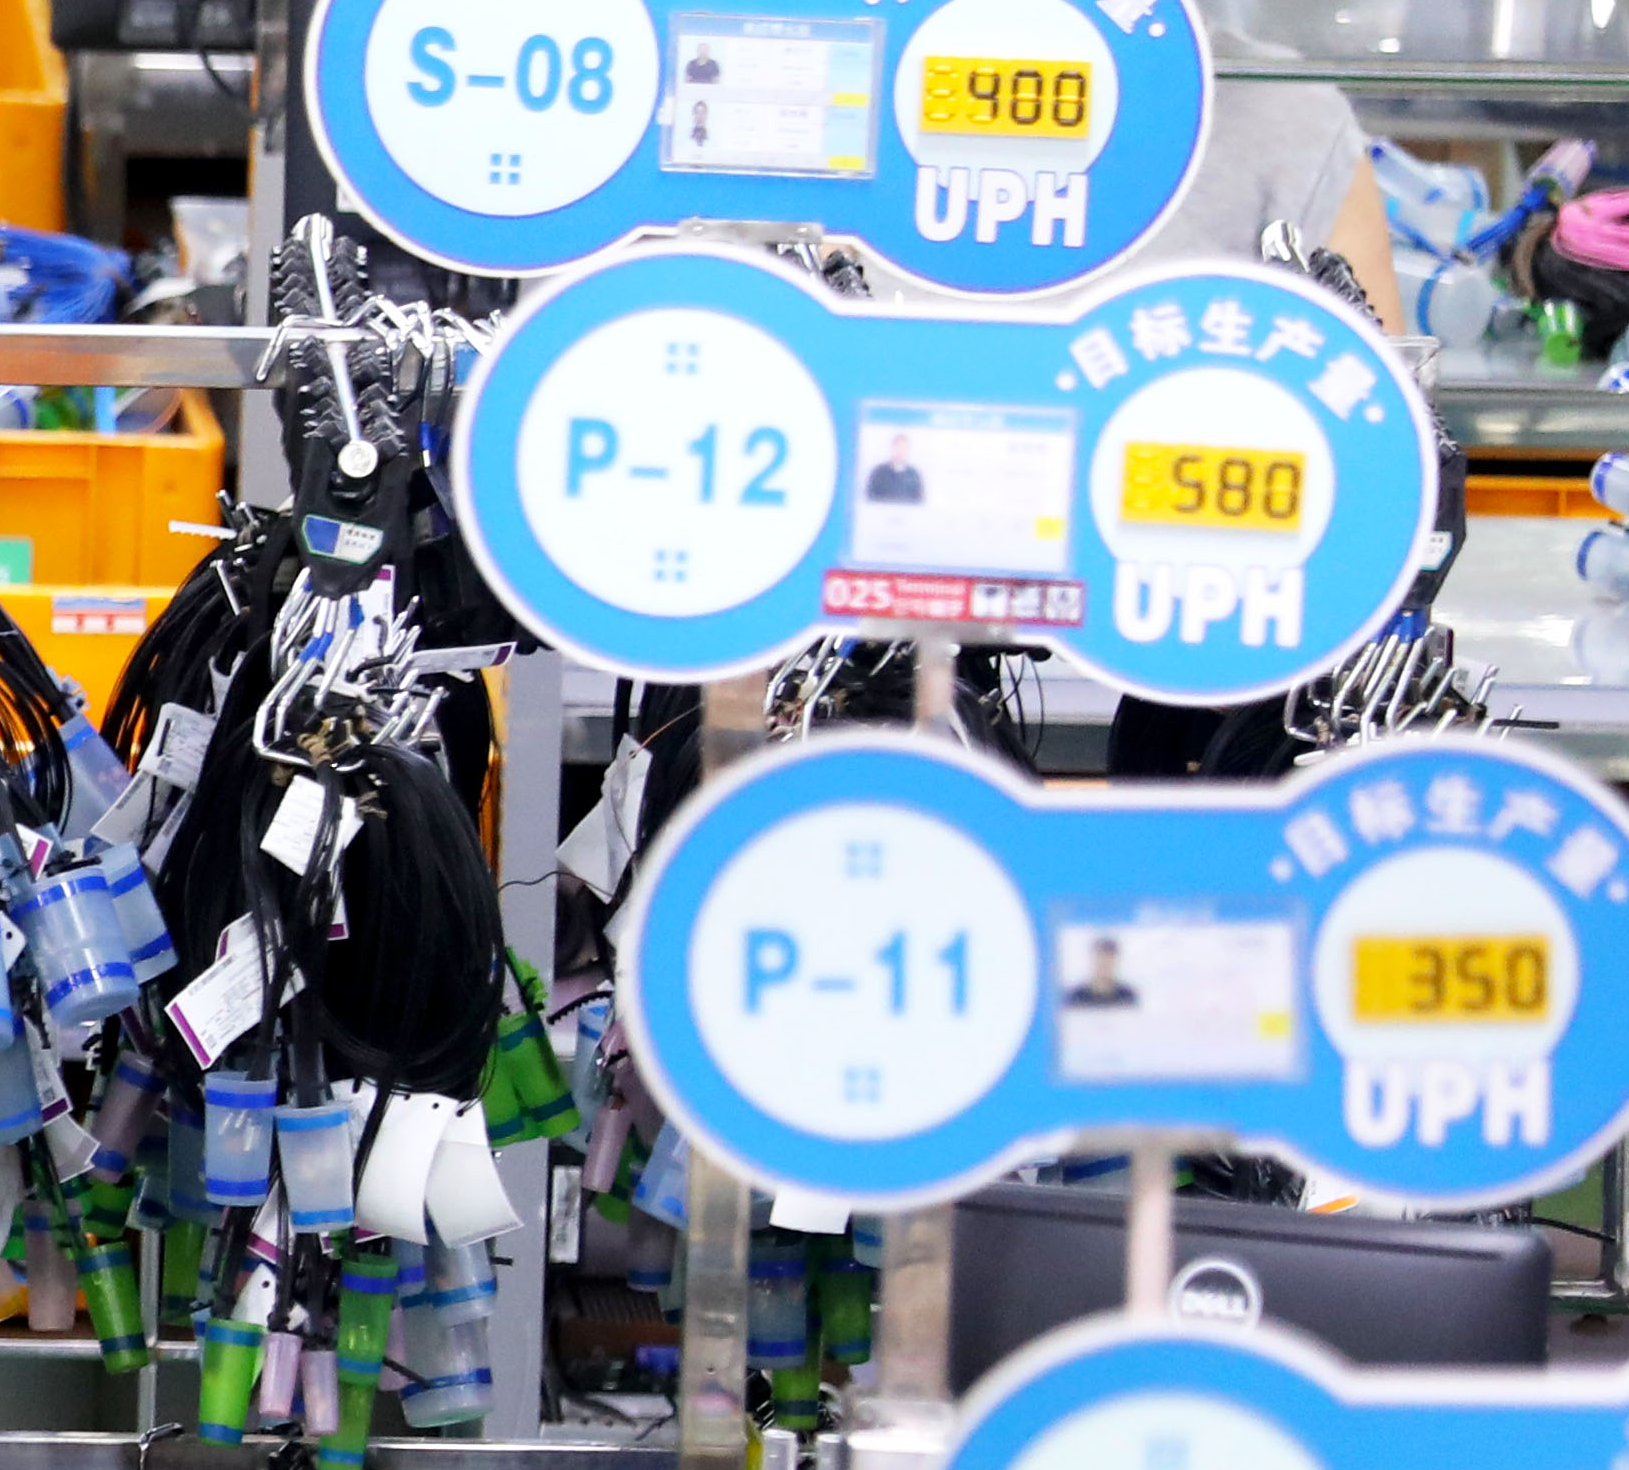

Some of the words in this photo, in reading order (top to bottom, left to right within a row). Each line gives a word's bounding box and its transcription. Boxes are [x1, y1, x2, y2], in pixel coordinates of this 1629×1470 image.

[405, 25, 616, 114] S-08
[964, 68, 1087, 131] 400
[913, 165, 1089, 249] UPH
[1067, 298, 1381, 421] 目标生产量
[564, 416, 790, 508] P-12
[1170, 452, 1304, 522] 580
[825, 577, 894, 609] 025
[1113, 559, 1304, 649] UPH
[1284, 775, 1613, 895] 目标生产量
[743, 927, 971, 1018] P-11
[1408, 946, 1549, 1014] 350
[1343, 1058, 1553, 1148] UPH
